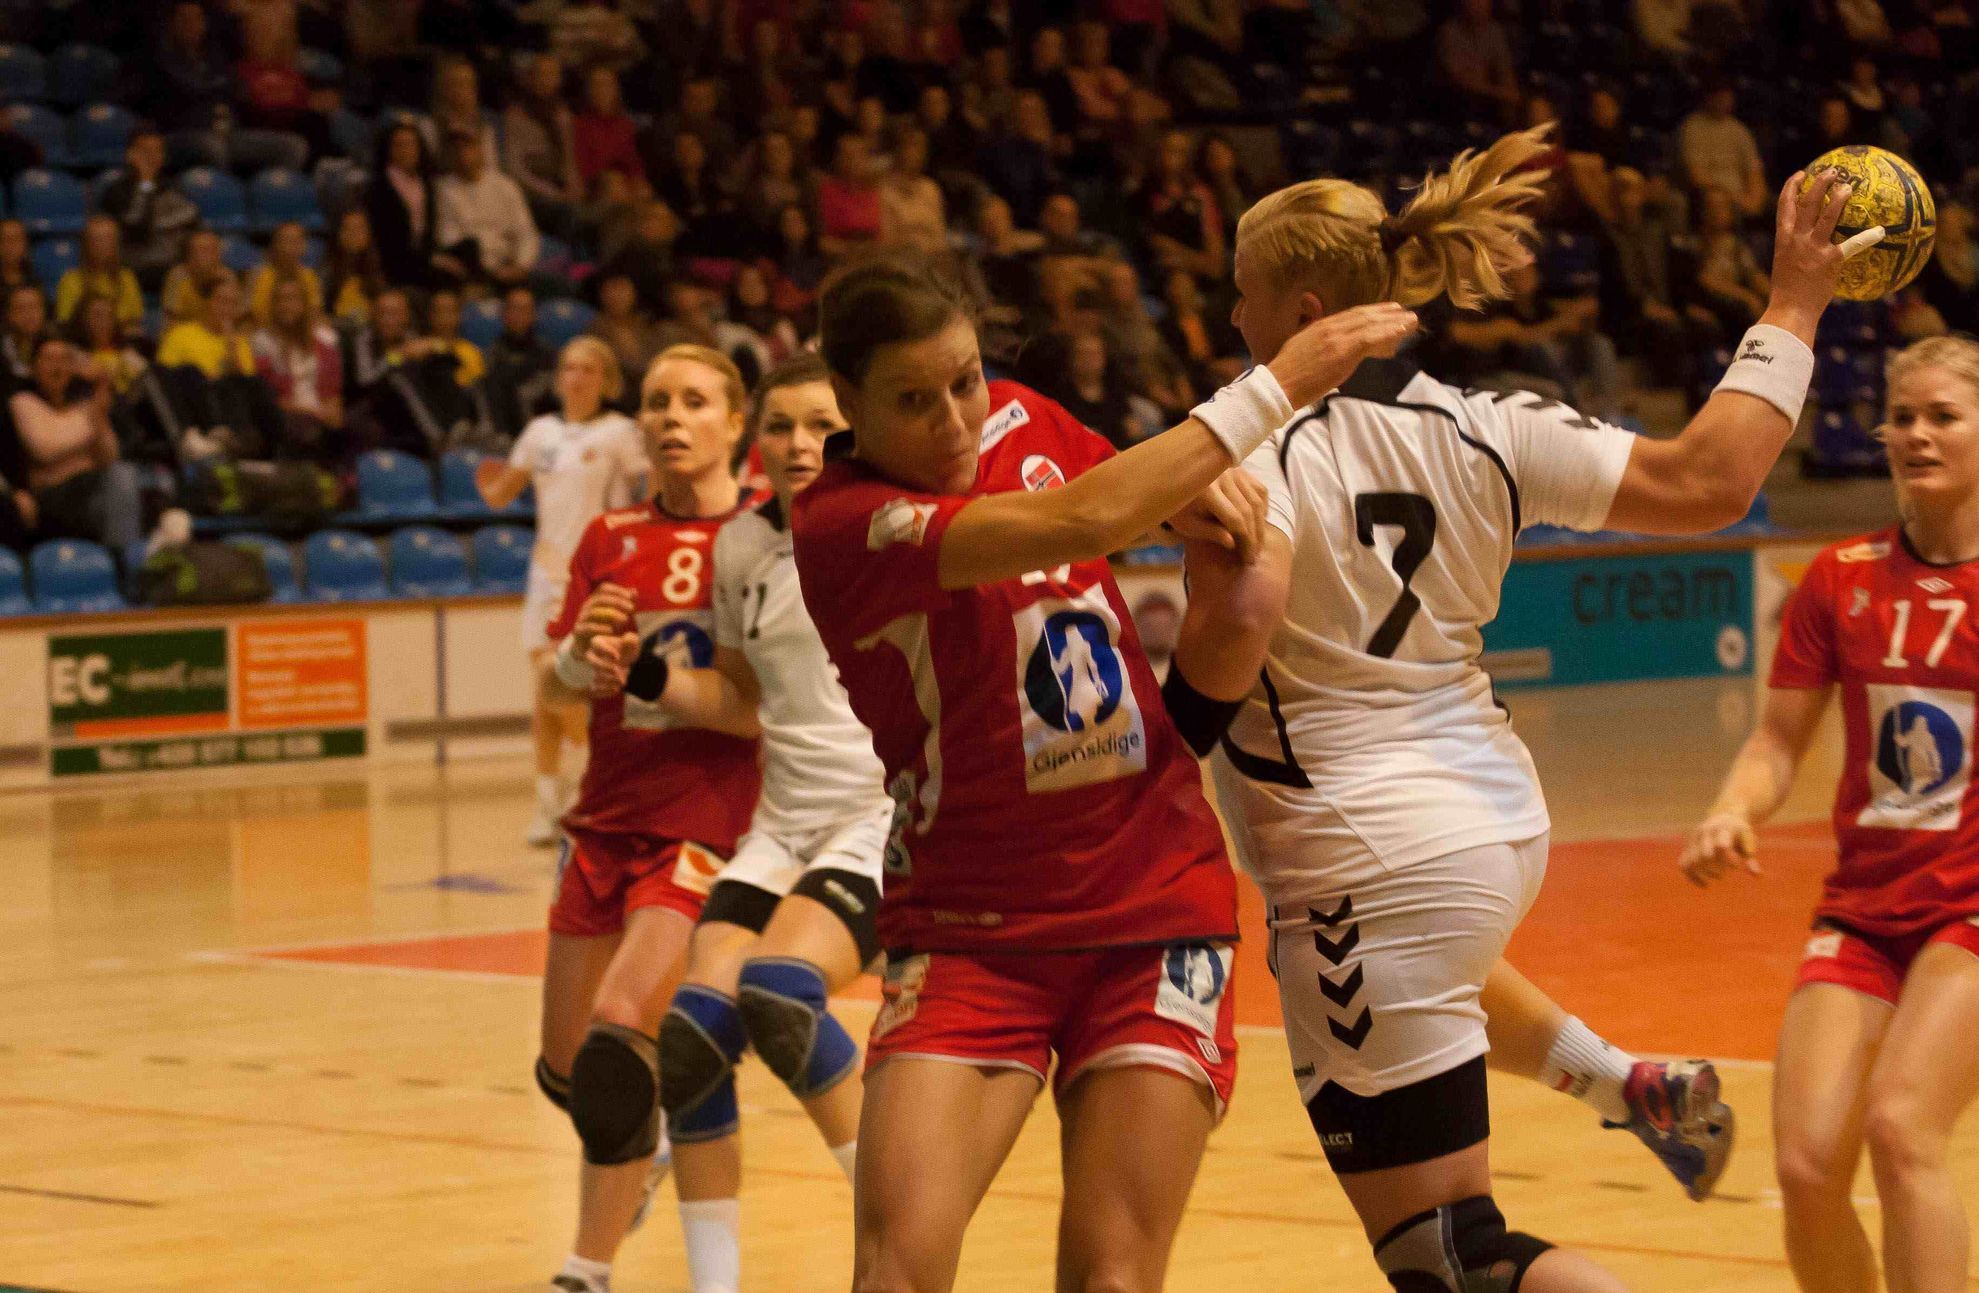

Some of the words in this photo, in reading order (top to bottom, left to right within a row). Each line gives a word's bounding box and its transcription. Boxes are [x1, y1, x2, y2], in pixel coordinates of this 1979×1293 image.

[662, 547, 703, 604] 8
[1355, 491, 1437, 659] 7
[1572, 566, 1737, 625] cream
[1882, 599, 1969, 668] 17
[50, 653, 111, 706] EC
[1319, 1132, 1353, 1146] LECT
